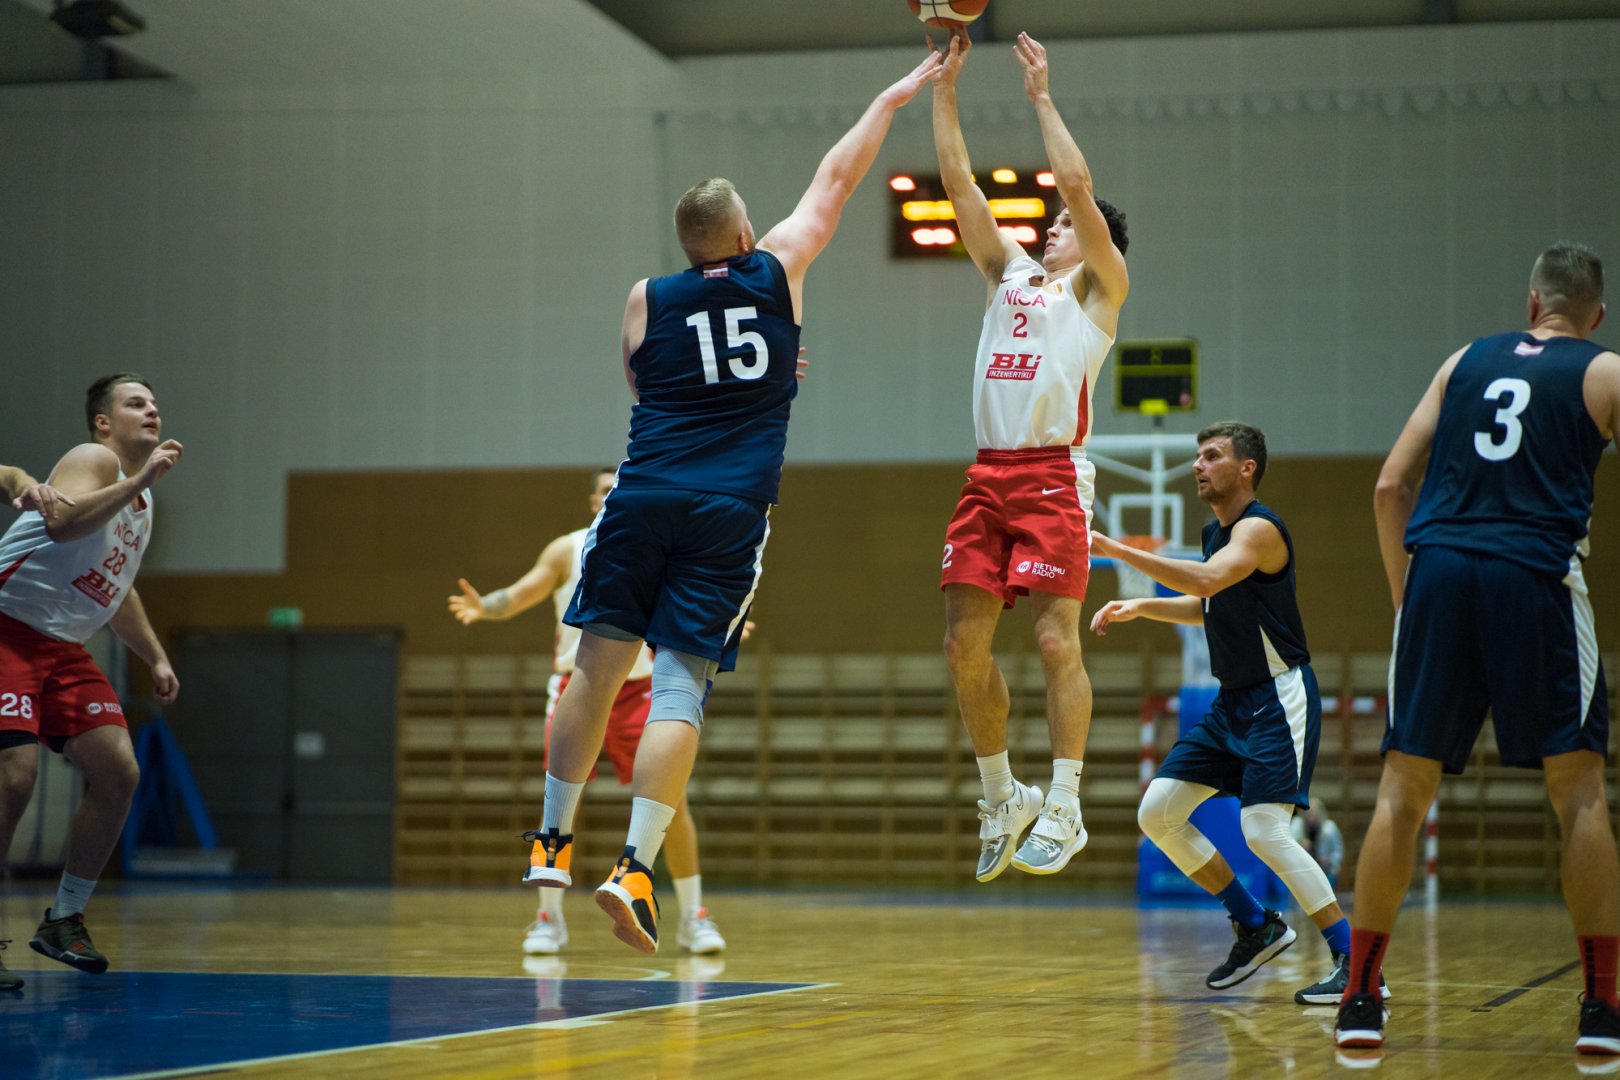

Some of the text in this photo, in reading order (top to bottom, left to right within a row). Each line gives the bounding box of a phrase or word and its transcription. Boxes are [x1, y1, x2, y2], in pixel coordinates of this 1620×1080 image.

[1012, 312, 1028, 338] 2
[686, 306, 769, 385] 15
[1474, 377, 1531, 461] 3
[102, 546, 127, 576] 28
[942, 543, 954, 569] 2
[1033, 561, 1066, 575] RIETUMU
[1031, 568, 1056, 579] RADIO
[0, 692, 32, 719] 28
